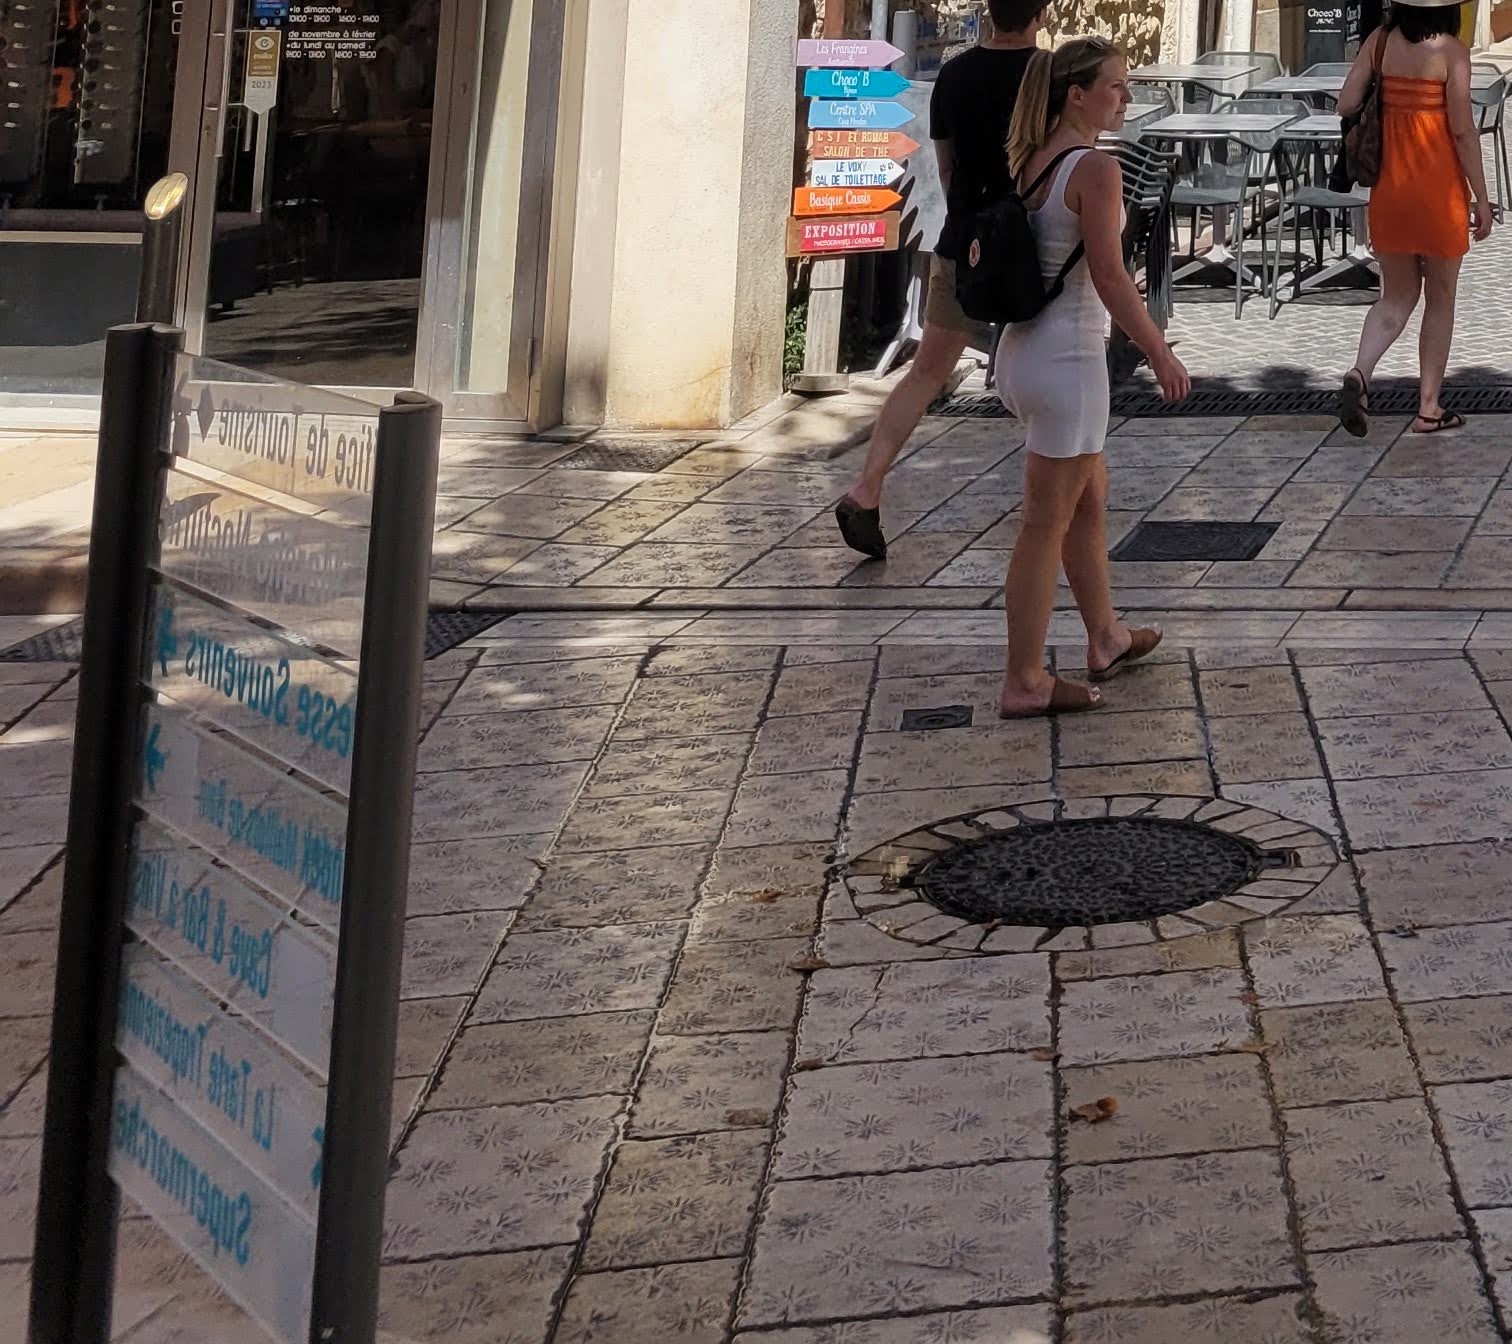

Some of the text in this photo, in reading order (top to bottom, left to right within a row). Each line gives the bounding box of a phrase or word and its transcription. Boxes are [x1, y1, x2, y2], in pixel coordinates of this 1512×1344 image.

[288, 29, 376, 38] de novembre à février
[816, 42, 867, 60] Les Frangines
[863, 71, 870, 86] B
[830, 102, 876, 116] Centre SPA
[847, 132, 858, 143] ET
[823, 146, 889, 158] SALON DE THE
[836, 162, 845, 172] LE
[815, 173, 887, 186] SAL DE TOILETTAGE
[809, 190, 871, 210] Basique Cassis
[804, 222, 876, 239] EXPOSITION
